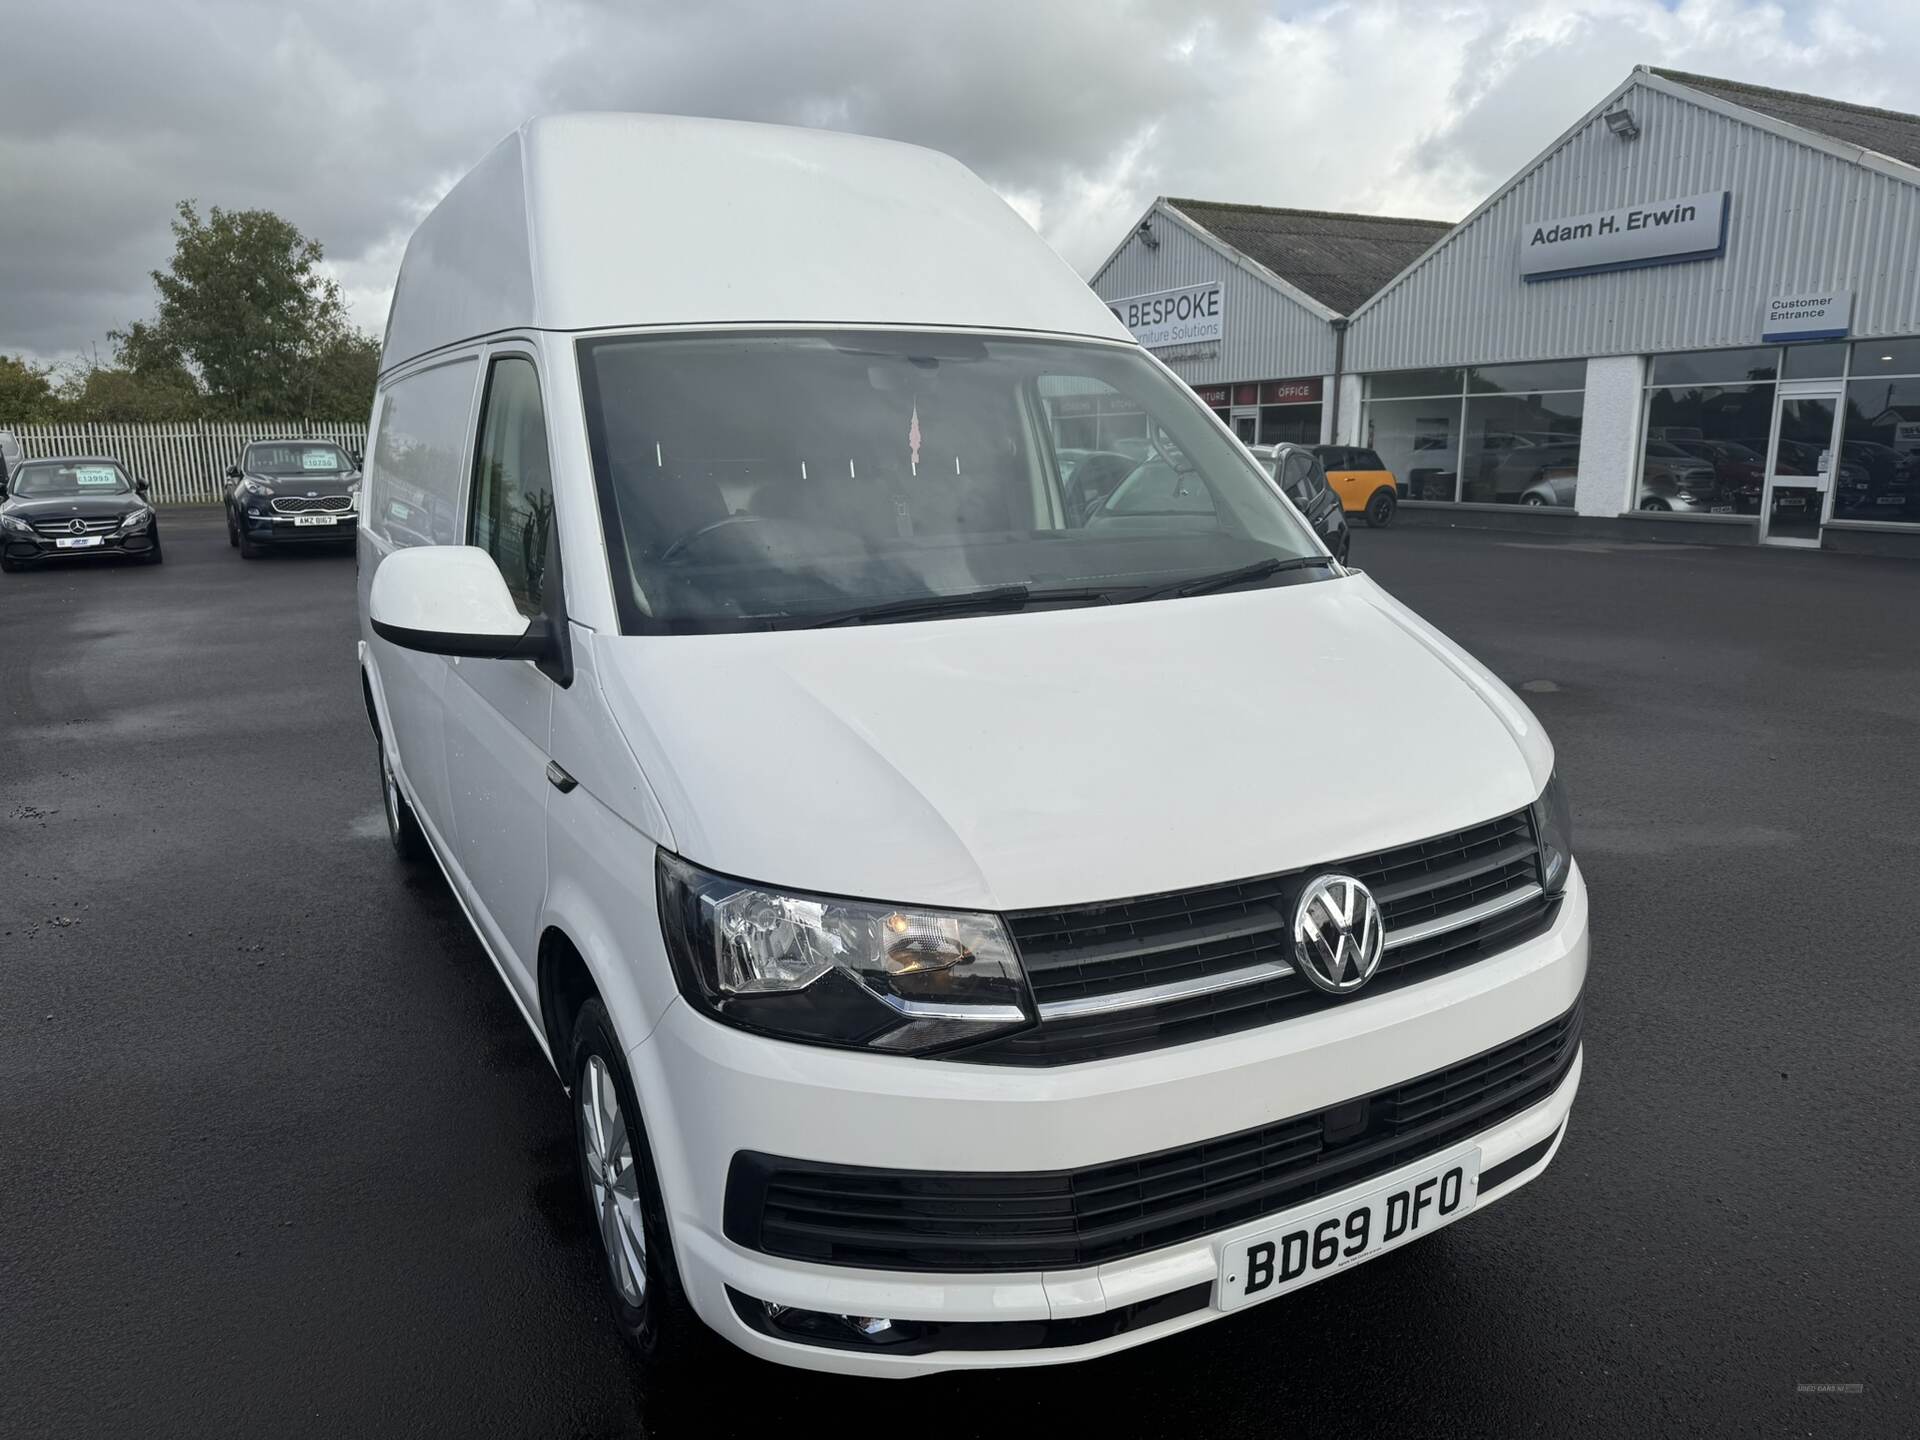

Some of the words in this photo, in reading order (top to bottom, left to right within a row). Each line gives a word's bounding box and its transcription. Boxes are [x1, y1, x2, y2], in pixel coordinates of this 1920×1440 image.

[1530, 223, 1592, 246] Adam
[1598, 215, 1620, 235] H.
[1627, 204, 1696, 231] Erwin
[1128, 290, 1219, 328] BESPOKE
[1772, 298, 1832, 309] Customer
[1770, 309, 1825, 320] Entrance
[1172, 324, 1218, 340] Solutions
[1278, 385, 1310, 397] OFFICE
[1244, 1206, 1371, 1296] BD69
